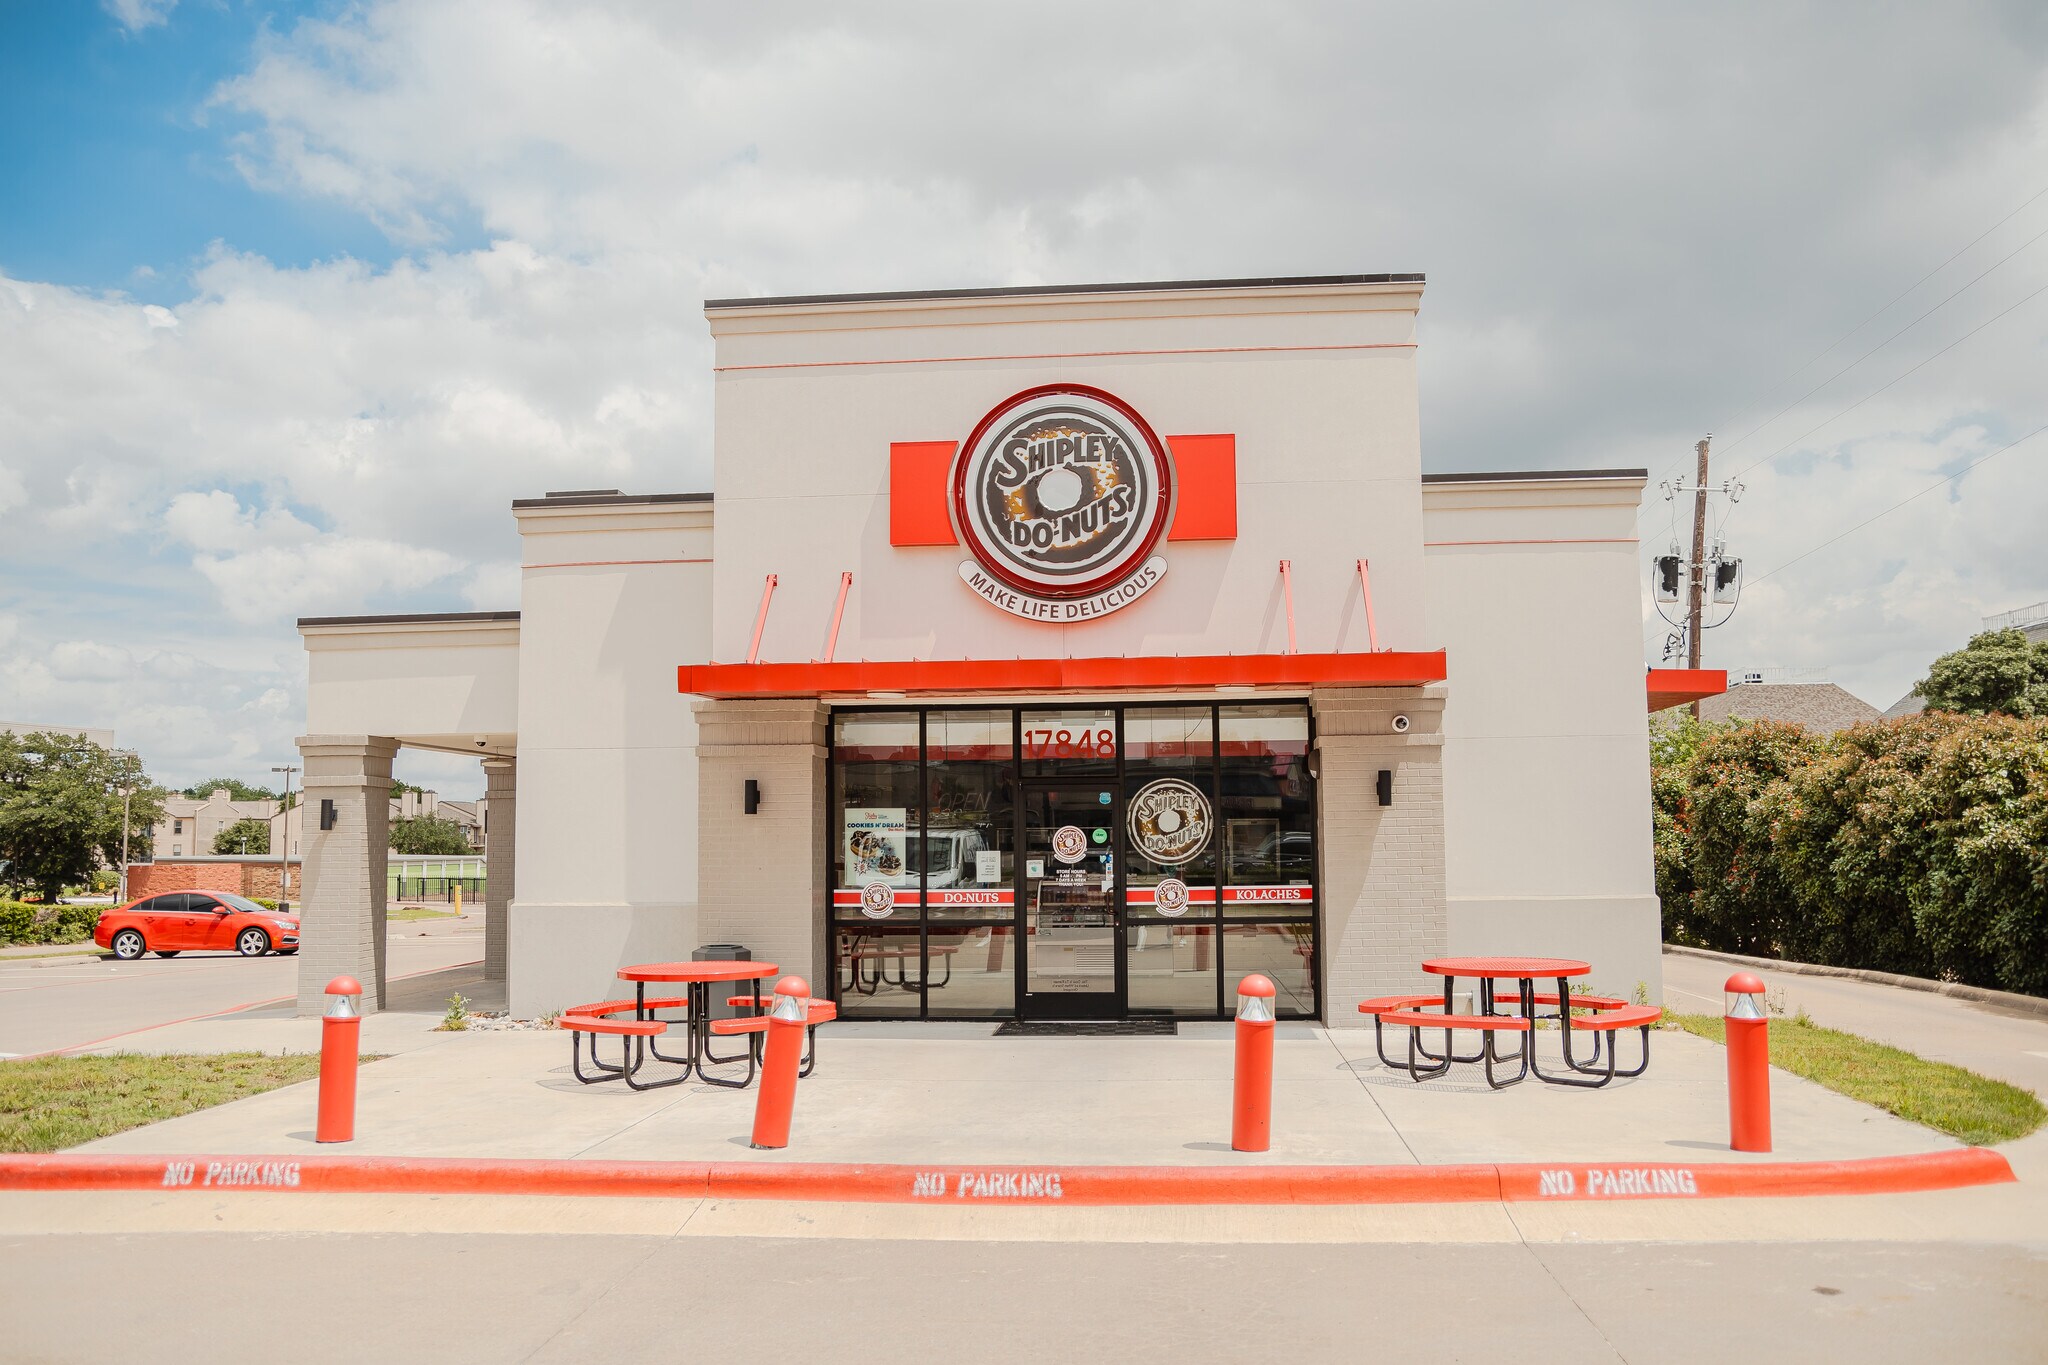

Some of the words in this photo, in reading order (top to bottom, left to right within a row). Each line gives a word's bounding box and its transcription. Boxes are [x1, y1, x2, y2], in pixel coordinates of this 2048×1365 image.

[996, 436, 1119, 488] SHIPLEY
[1013, 486, 1128, 548] DO-NUTS
[969, 572, 1016, 610] MAKE
[1021, 600, 1060, 619] LIFE
[1066, 566, 1158, 619] DELICIOUS
[1024, 729, 1116, 759] 17848
[939, 791, 992, 811] OPEN
[1138, 795, 1200, 819] SHIPLEY
[944, 892, 999, 903] DO-NUTS
[1236, 889, 1301, 900] KOLACHES
[162, 1161, 196, 1186] NO
[203, 1161, 301, 1187] PARKING
[912, 1172, 946, 1197] NO
[957, 1172, 1063, 1198] PARKING
[1540, 1169, 1575, 1195] NO
[1587, 1168, 1698, 1194] PARKING
